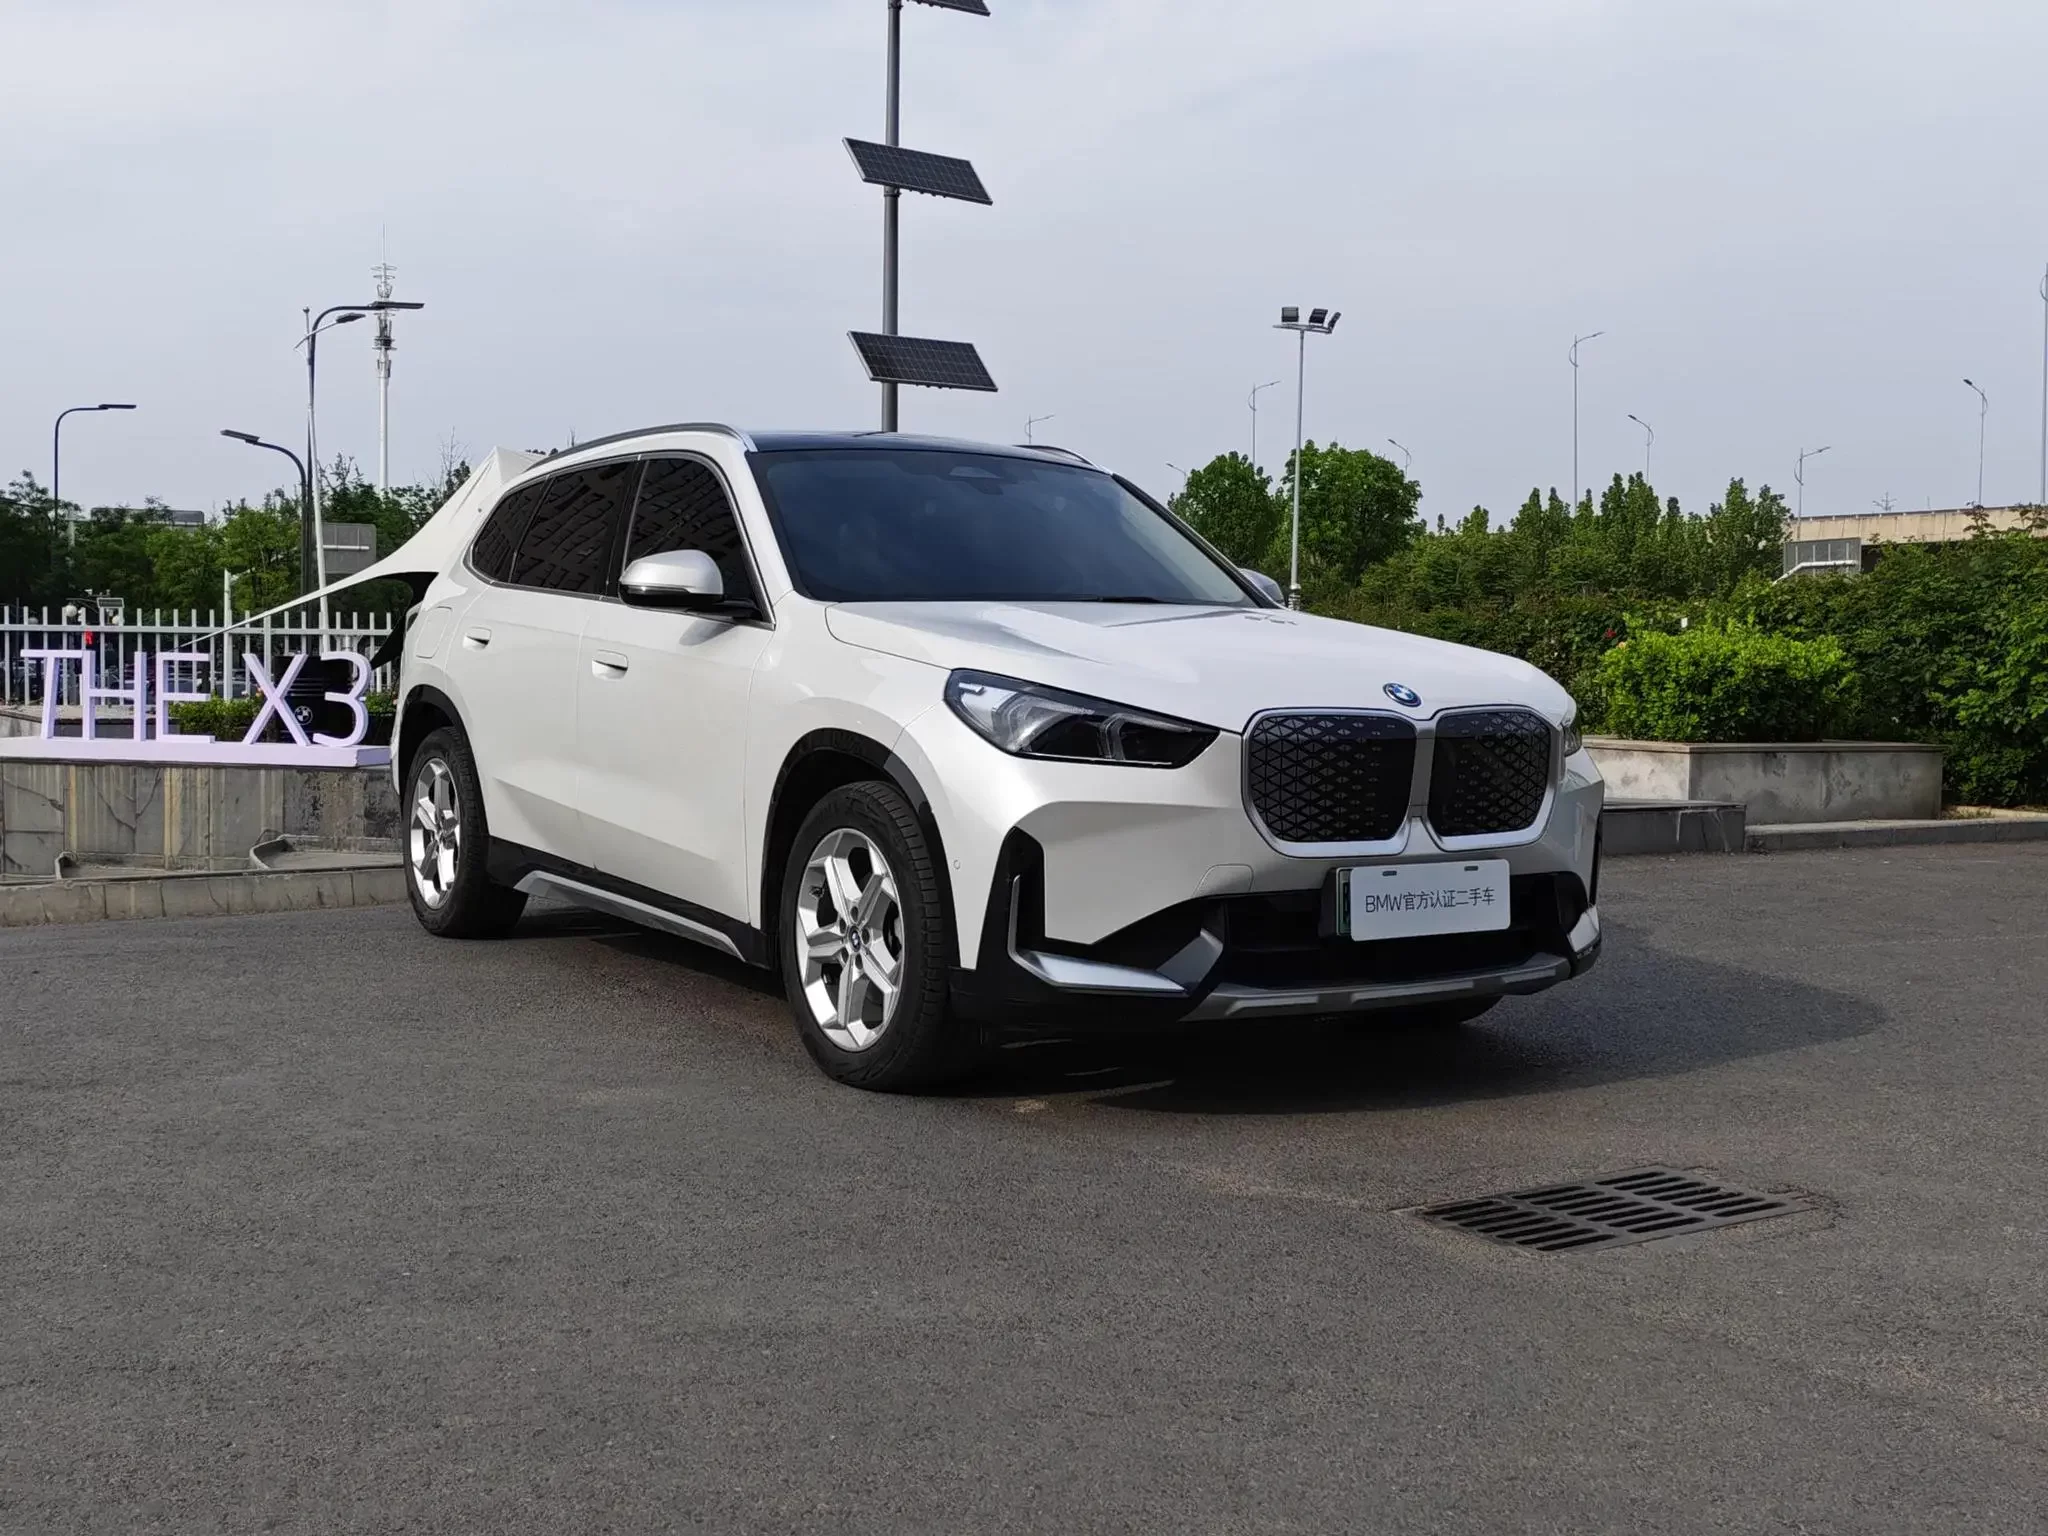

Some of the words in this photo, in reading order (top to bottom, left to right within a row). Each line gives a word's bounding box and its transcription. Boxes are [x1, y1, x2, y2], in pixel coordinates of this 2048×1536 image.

[20, 649, 216, 743] THE
[241, 651, 372, 747] X3
[1365, 886, 1495, 913] BMW官方认证二手车
